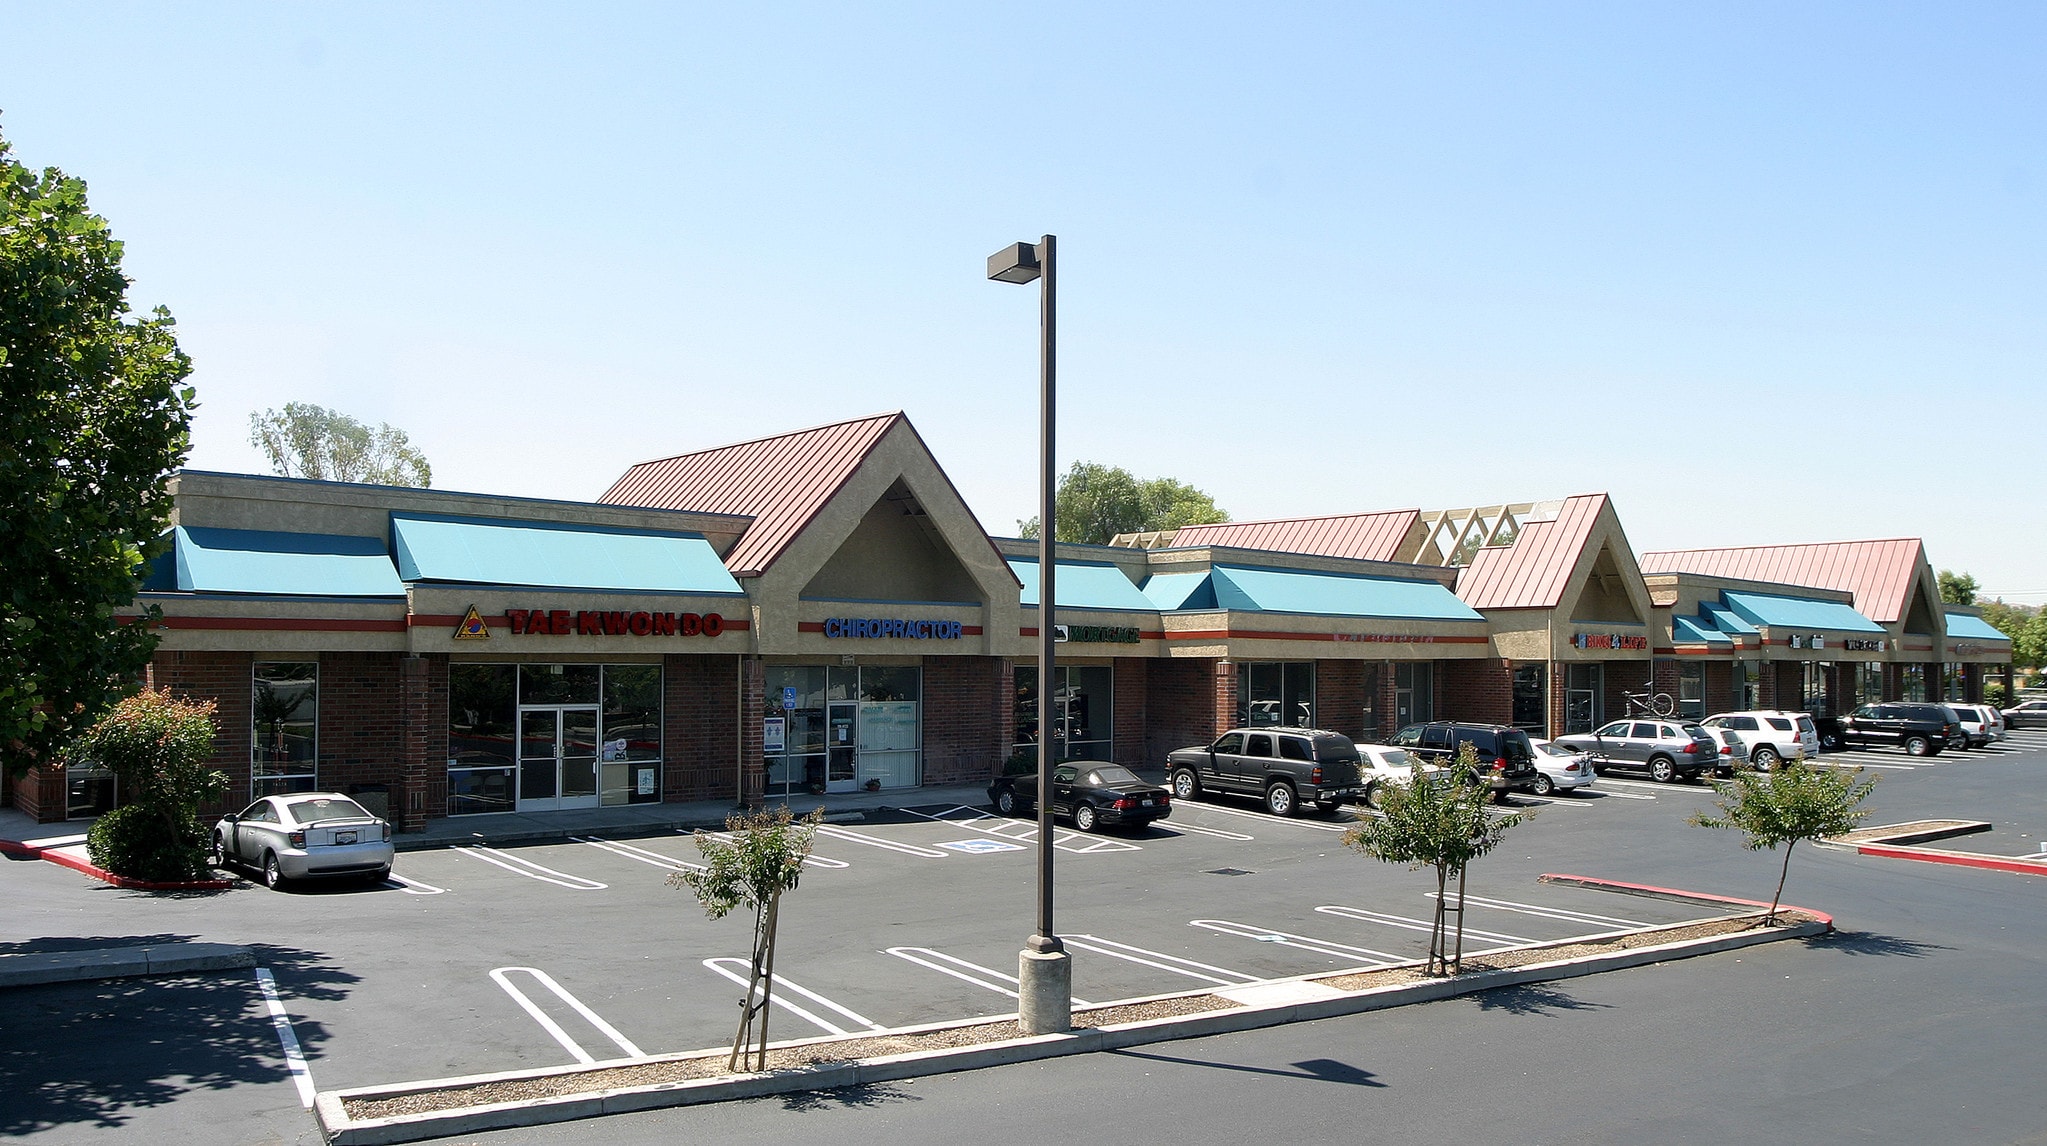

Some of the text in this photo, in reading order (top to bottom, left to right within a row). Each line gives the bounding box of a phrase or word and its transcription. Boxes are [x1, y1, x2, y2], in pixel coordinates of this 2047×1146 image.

[506, 609, 724, 637] TAE KWON DO
[825, 617, 962, 640] CHIROPRACTOR
[1068, 625, 1141, 643] MORTGAGE
[1621, 635, 1647, 650] LIFE
